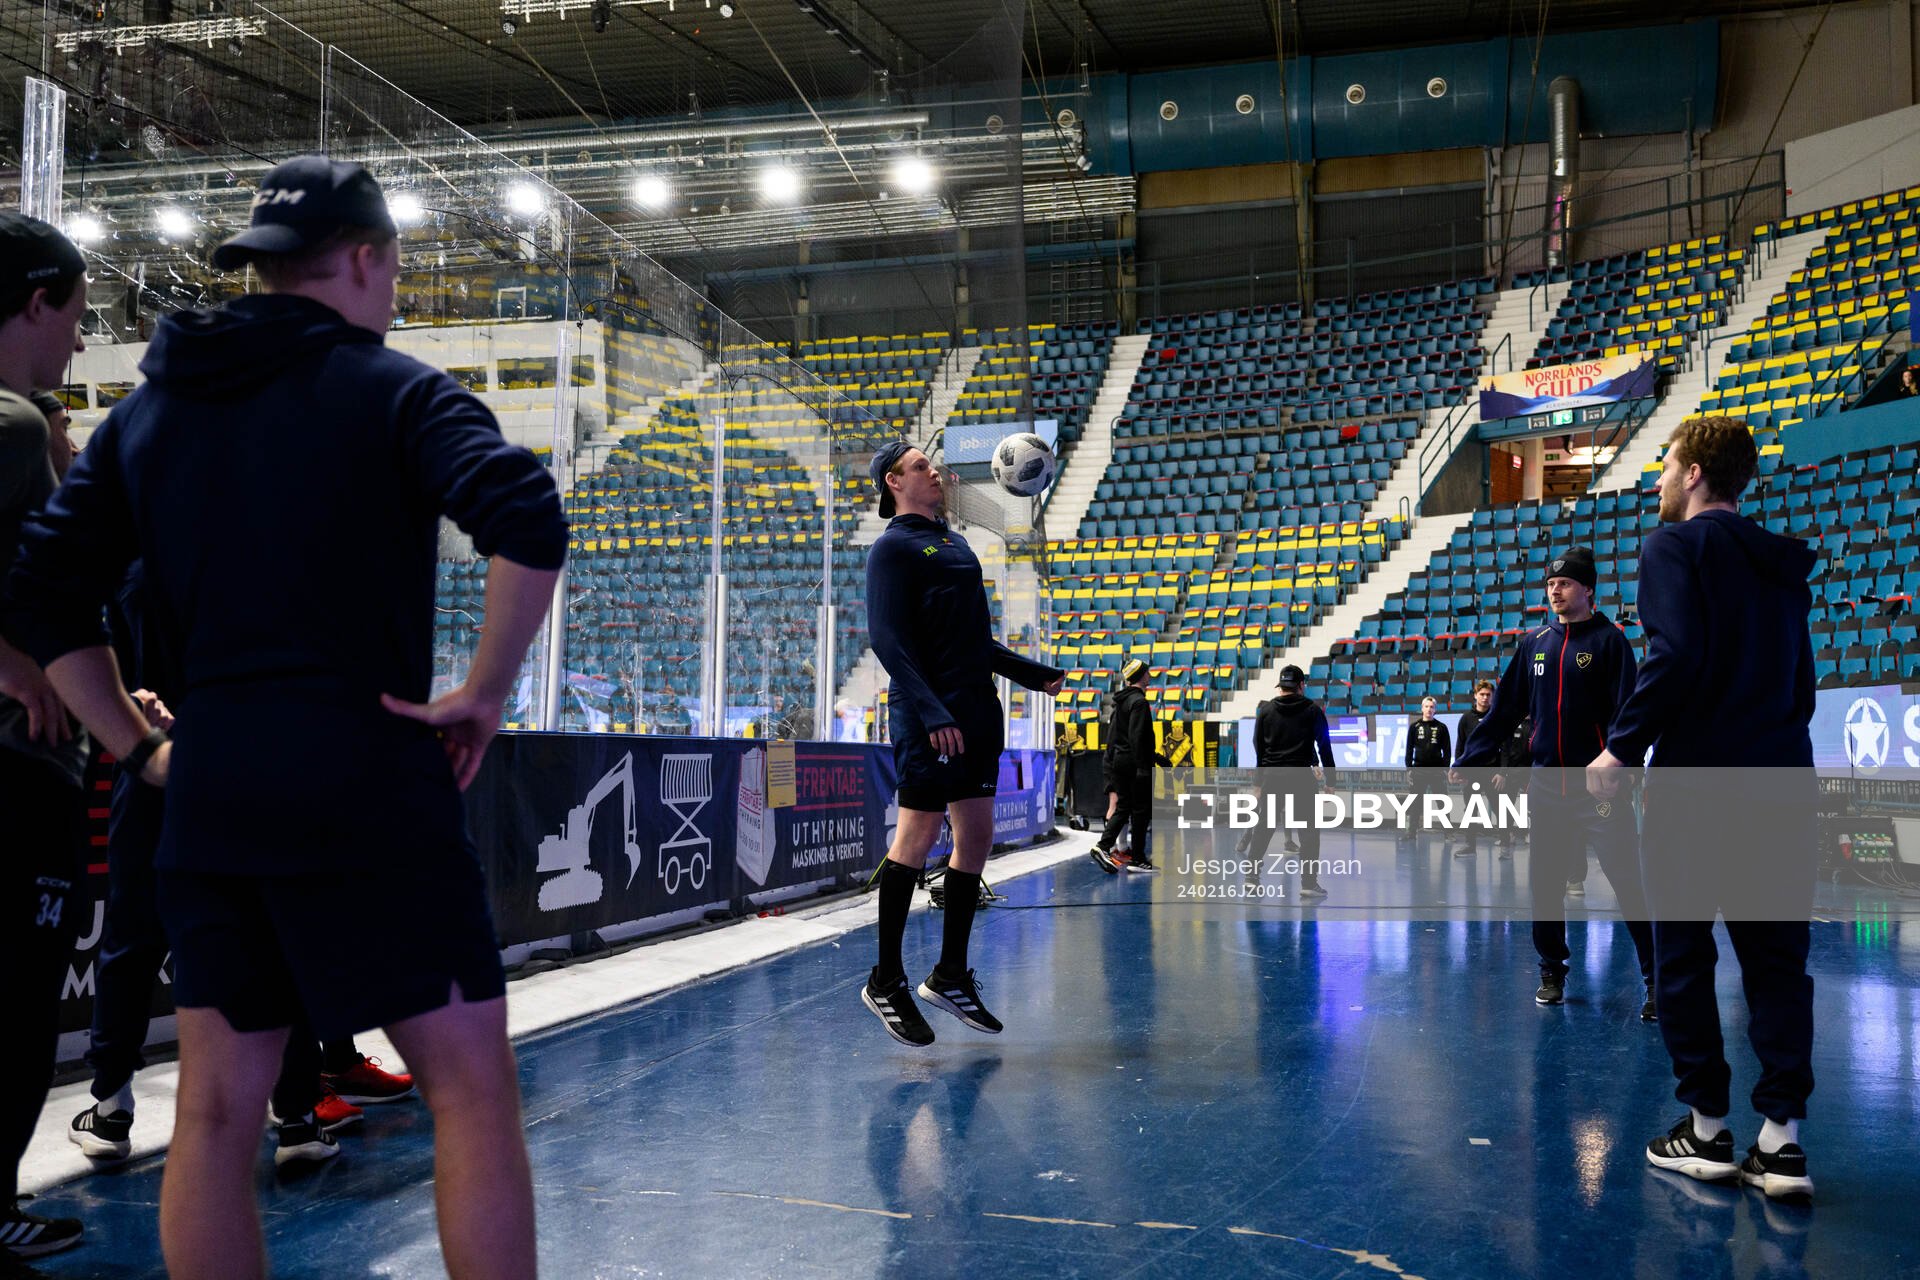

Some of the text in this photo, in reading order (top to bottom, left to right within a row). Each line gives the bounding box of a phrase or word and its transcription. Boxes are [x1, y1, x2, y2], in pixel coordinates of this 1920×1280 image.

[1525, 363, 1602, 387] NORRLANDS
[1534, 377, 1594, 398] GULD
[1533, 663, 1545, 676] 10
[994, 800, 1028, 819] UTHYRNING
[792, 816, 865, 847] UTHYRNING
[792, 847, 828, 869] MASKINER
[829, 847, 835, 862] &
[36, 893, 63, 928] 34
